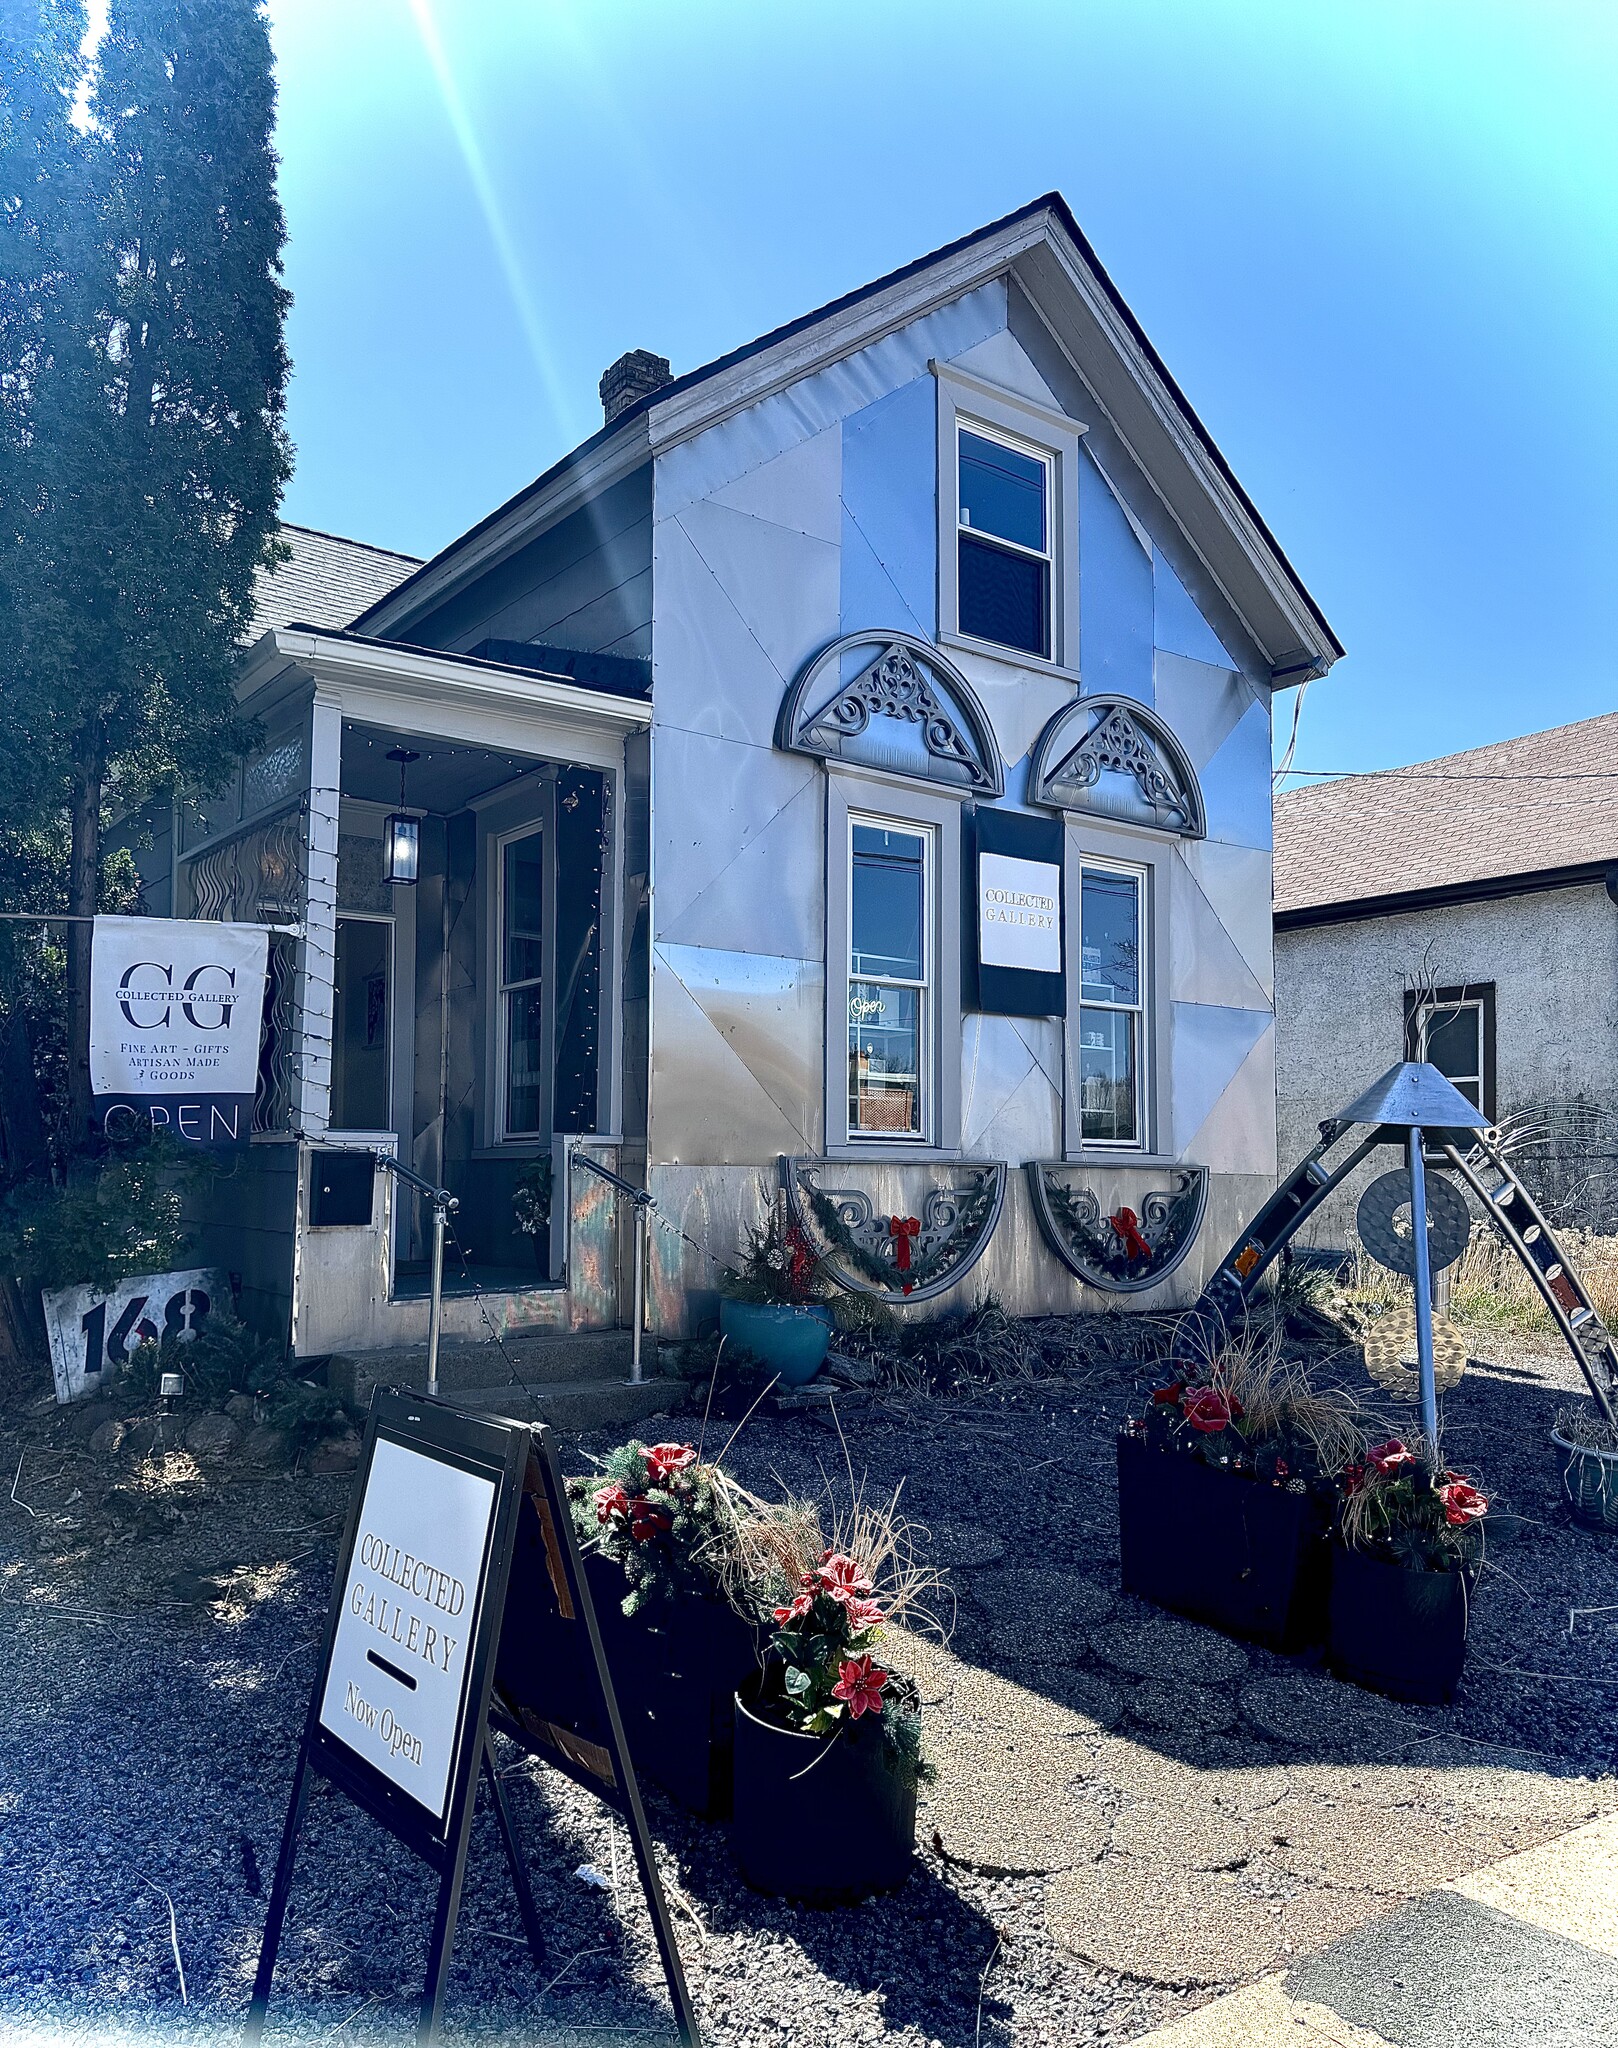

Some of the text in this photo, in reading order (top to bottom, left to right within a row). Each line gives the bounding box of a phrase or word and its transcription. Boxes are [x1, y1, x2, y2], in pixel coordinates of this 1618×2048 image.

[985, 889, 1054, 911] COLLECTED
[985, 908, 1054, 929] GALLERY
[115, 990, 239, 1003] COLLECTED GALLERY
[119, 962, 236, 1030] CG
[850, 997, 885, 1021] Open
[120, 1043, 146, 1054] FINE
[150, 1044, 178, 1054] ART
[194, 1044, 230, 1054] GIFTS
[128, 1057, 220, 1067] ARTISAN MADE
[150, 1071, 195, 1080] GOODS
[104, 1104, 239, 1141] OPEN
[81, 1289, 211, 1374] 168
[361, 1533, 464, 1617] COLLECTED
[351, 1582, 457, 1674] GALLERY
[344, 1681, 422, 1766] Now Open
